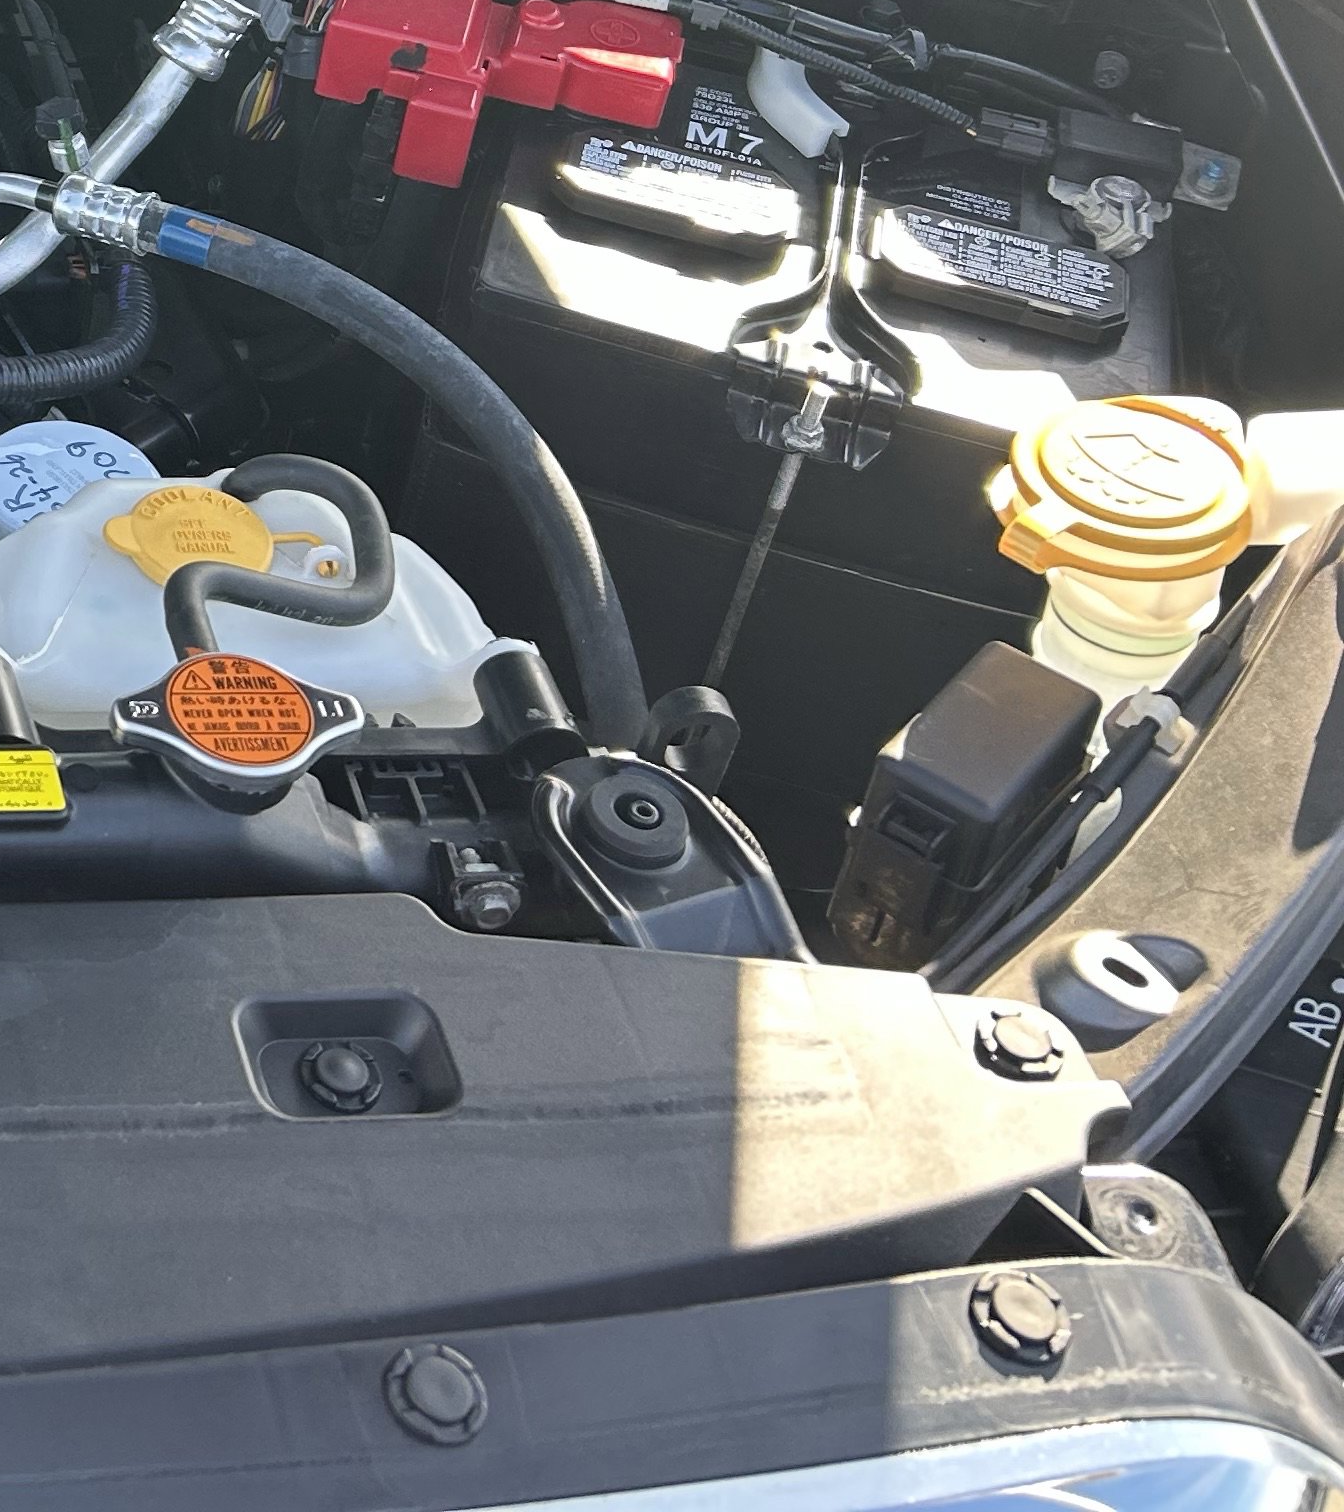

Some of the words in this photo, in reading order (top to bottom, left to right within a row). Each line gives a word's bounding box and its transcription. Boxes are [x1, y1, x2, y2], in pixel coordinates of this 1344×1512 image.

[690, 114, 733, 127] GROUP
[715, 107, 749, 120] AMPS
[686, 120, 728, 148] M
[738, 132, 763, 155] 7
[636, 143, 723, 174] DANGER/POISON
[936, 184, 995, 202] DISTRIBUTED
[955, 222, 1049, 253] DANGER/POISON
[141, 489, 252, 520] COOLANT
[176, 541, 235, 554] MANUAL
[208, 659, 251, 674] 警告
[212, 676, 278, 690] WARNING
[183, 709, 213, 719] NEVER
[218, 709, 243, 718] OPEN
[247, 708, 274, 718] WHEN
